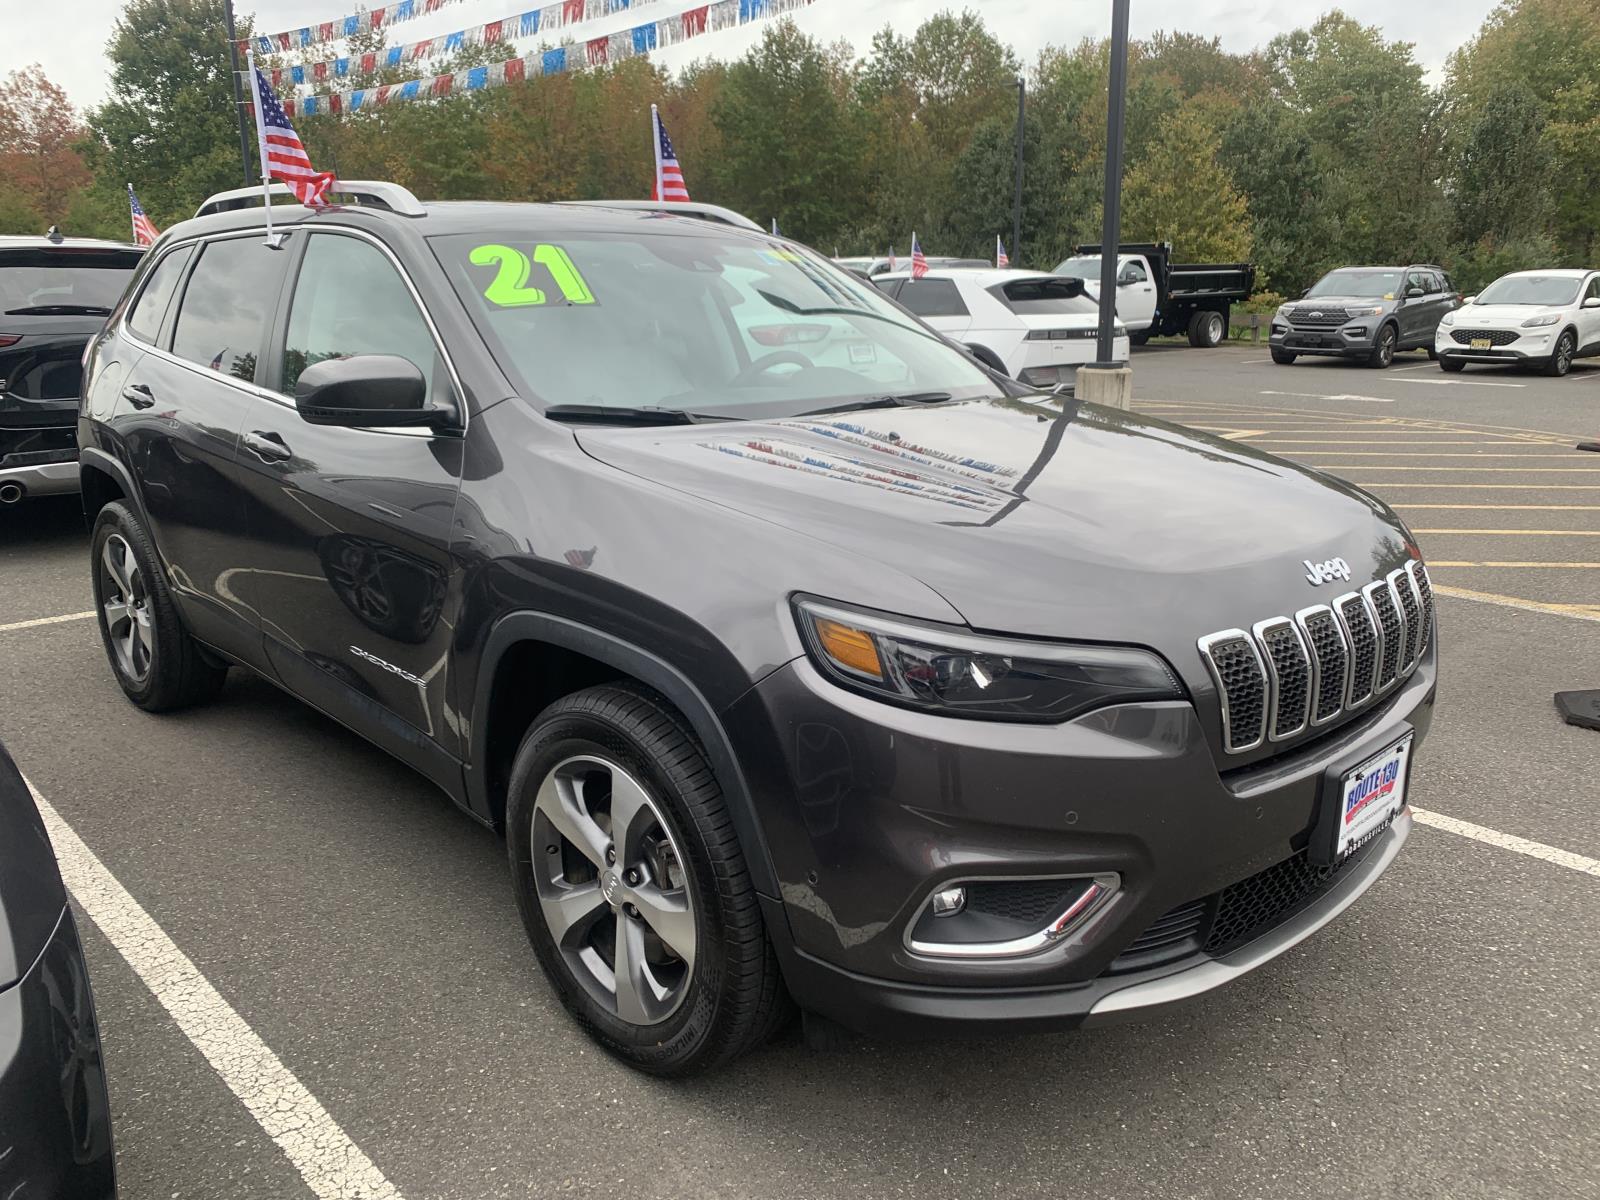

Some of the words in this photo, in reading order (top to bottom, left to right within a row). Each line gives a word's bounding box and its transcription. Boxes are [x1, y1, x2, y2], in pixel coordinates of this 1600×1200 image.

[469, 244, 595, 307] 21
[1302, 557, 1351, 586] Jeep
[349, 645, 427, 689] CHEROKEE
[1346, 768, 1382, 812] ROUTE
[1382, 759, 1400, 783] 130
